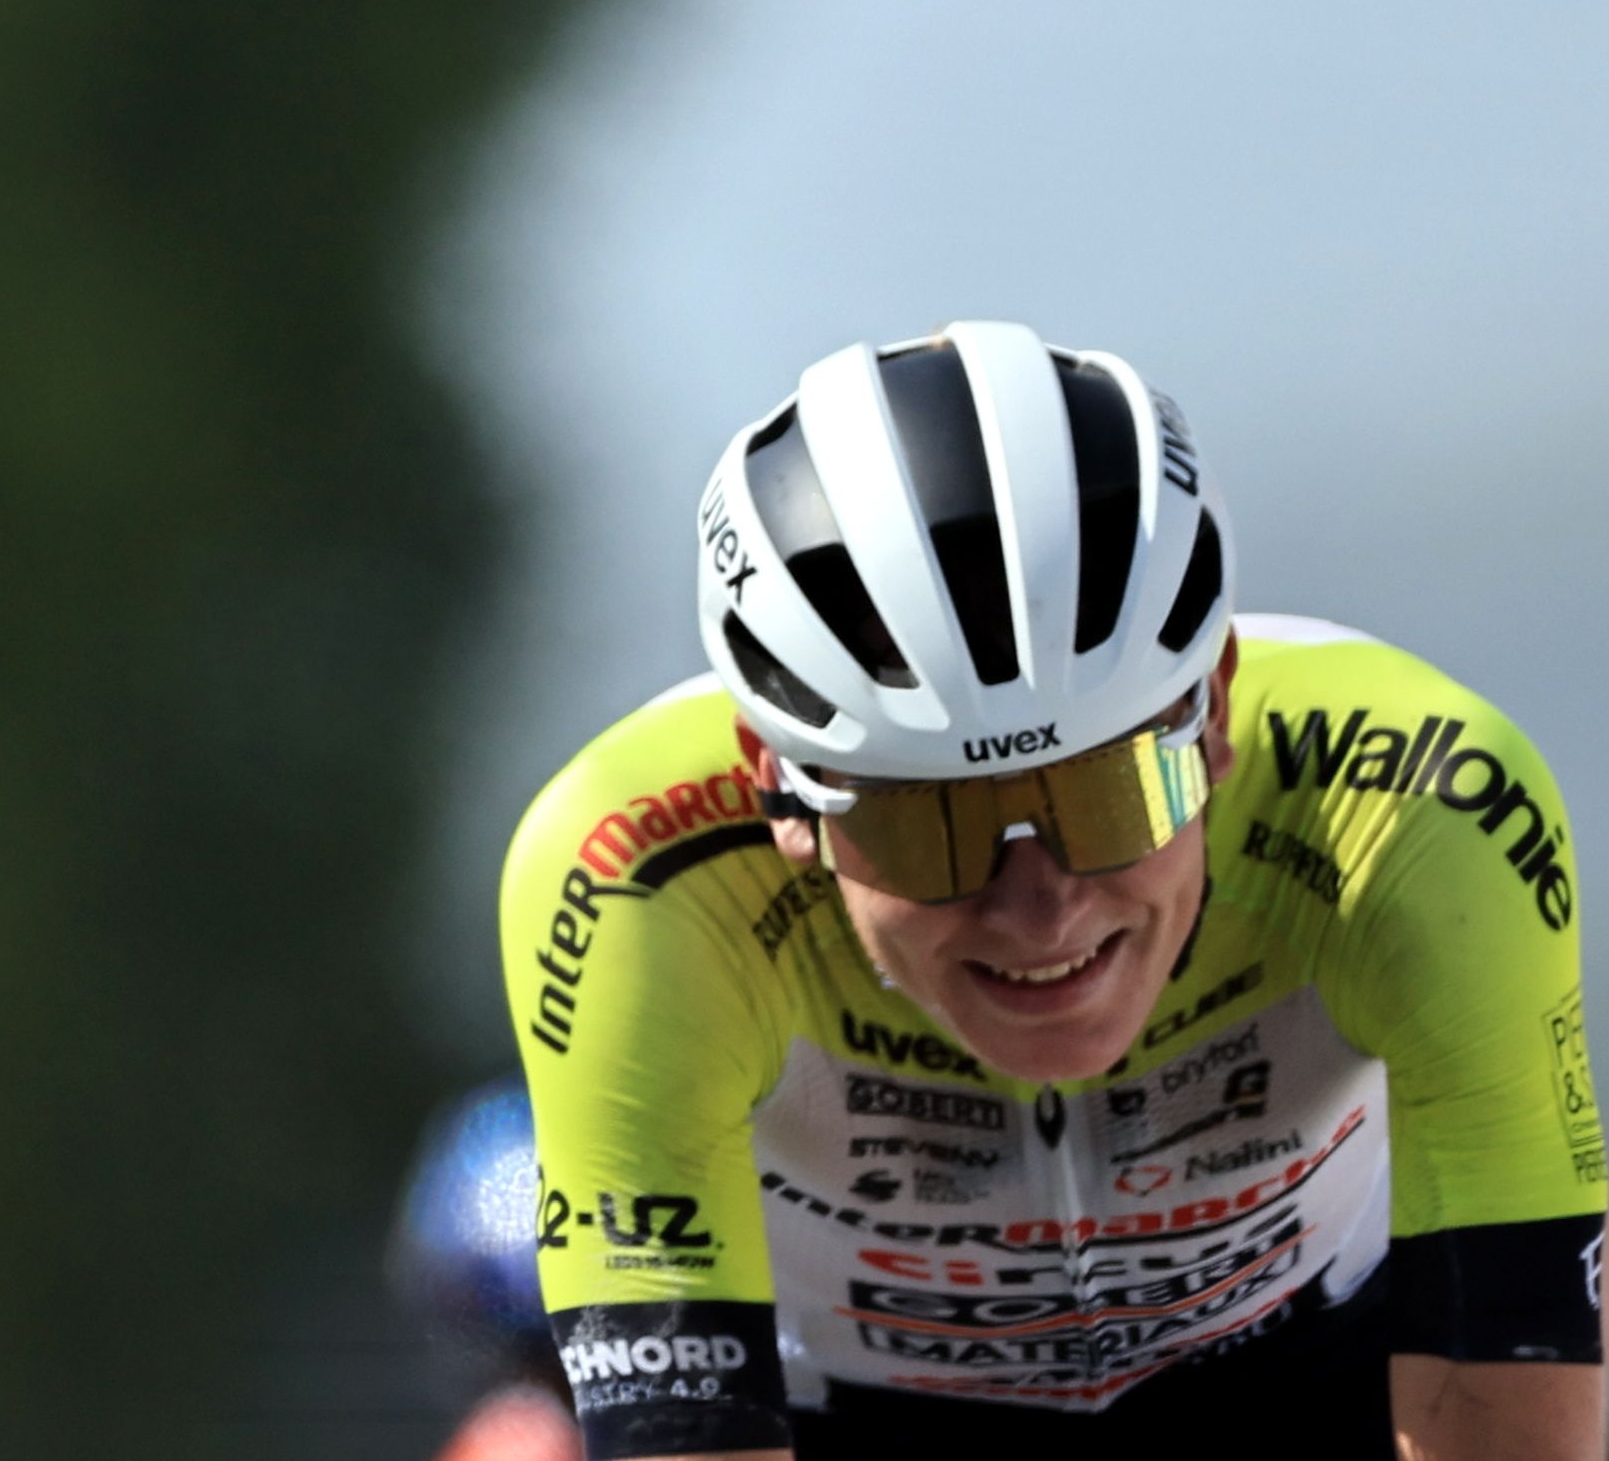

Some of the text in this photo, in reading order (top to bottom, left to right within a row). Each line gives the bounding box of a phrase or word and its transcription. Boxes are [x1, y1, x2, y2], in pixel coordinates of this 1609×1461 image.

[701, 477, 758, 606] uvex
[963, 722, 1062, 765] uvex
[1266, 707, 1573, 932] Wallonie
[529, 763, 756, 1056] Intermarch
